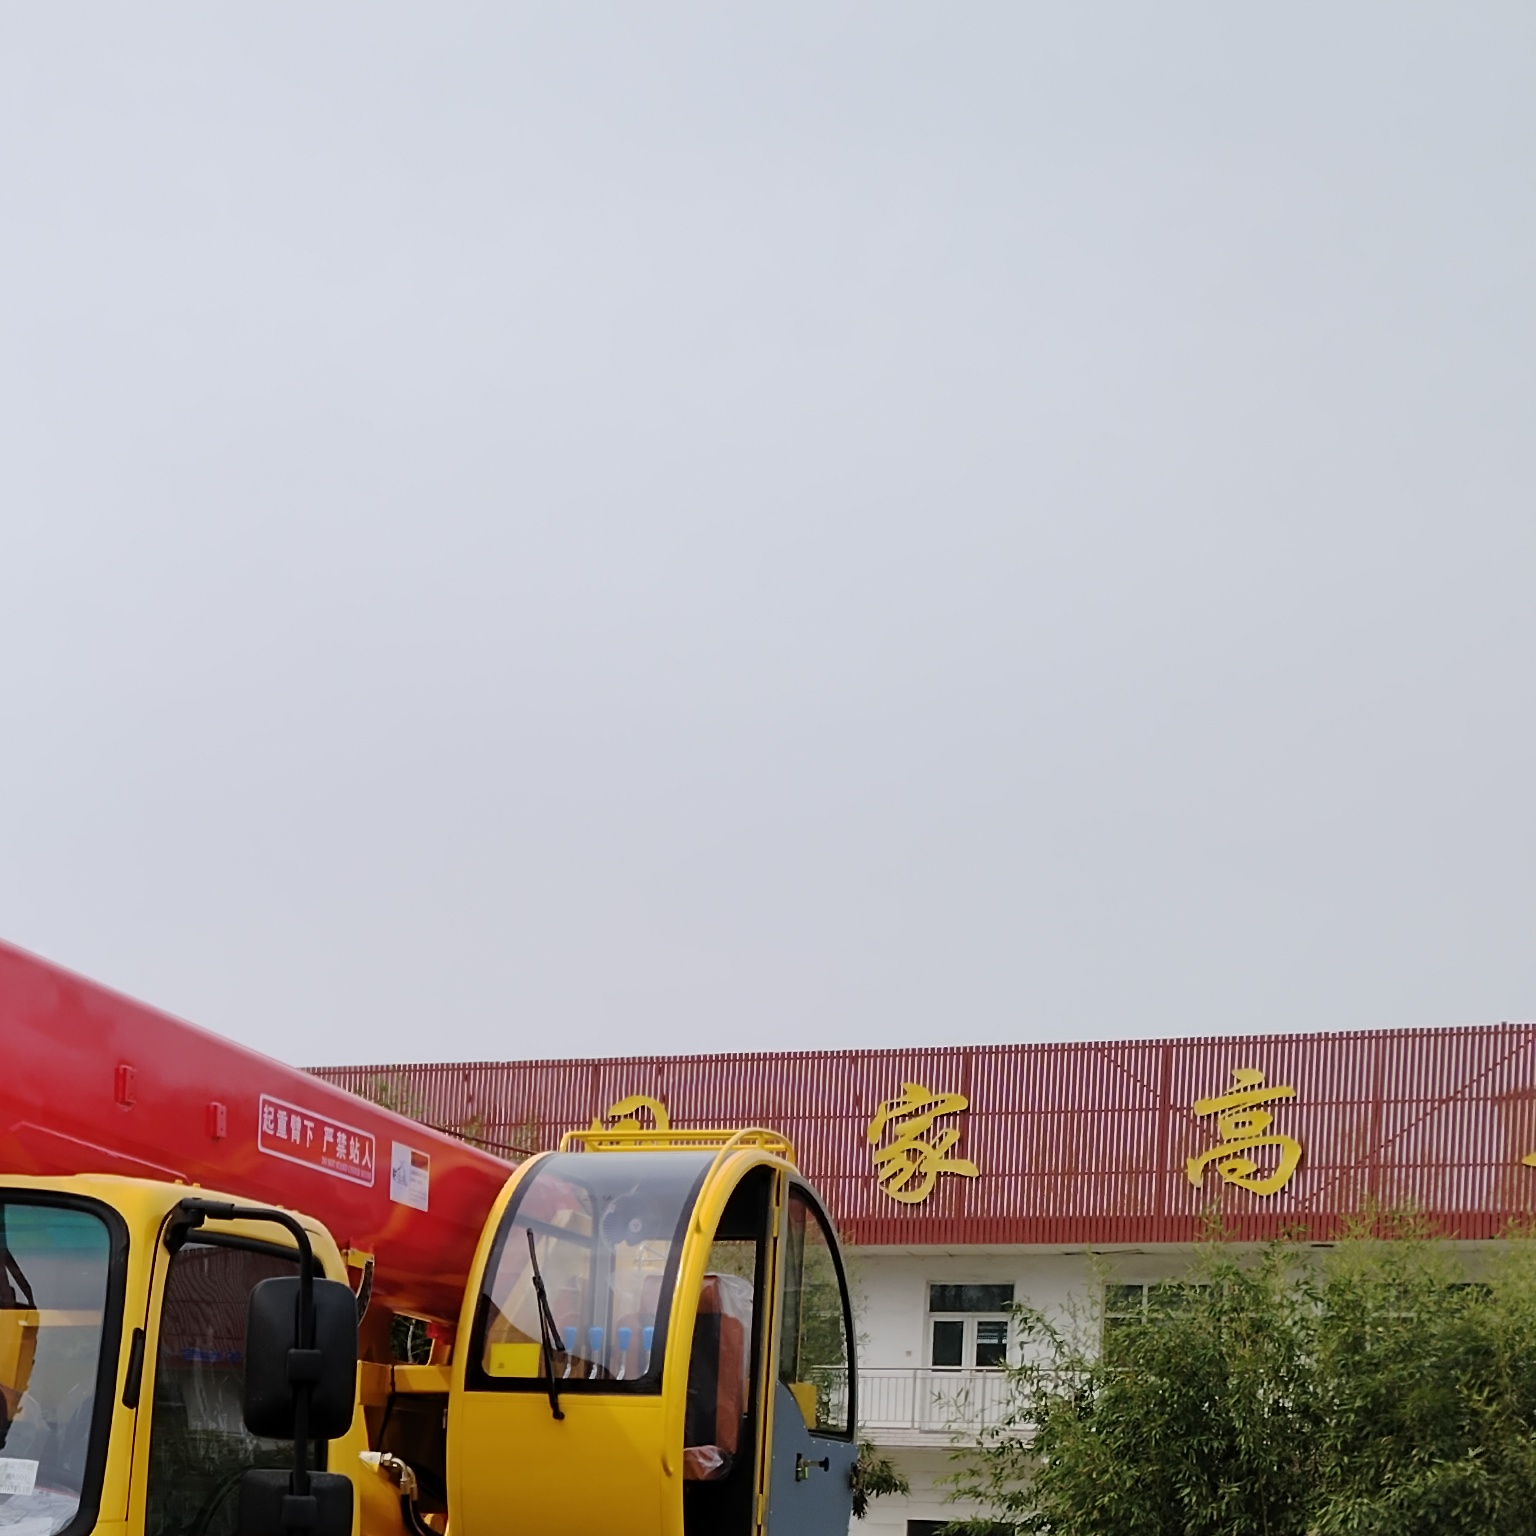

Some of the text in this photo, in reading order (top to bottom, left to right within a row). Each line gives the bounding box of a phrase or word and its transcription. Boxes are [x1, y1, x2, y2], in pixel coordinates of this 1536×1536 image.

[262, 1104, 372, 1168] 起重臂下 严禁站人
